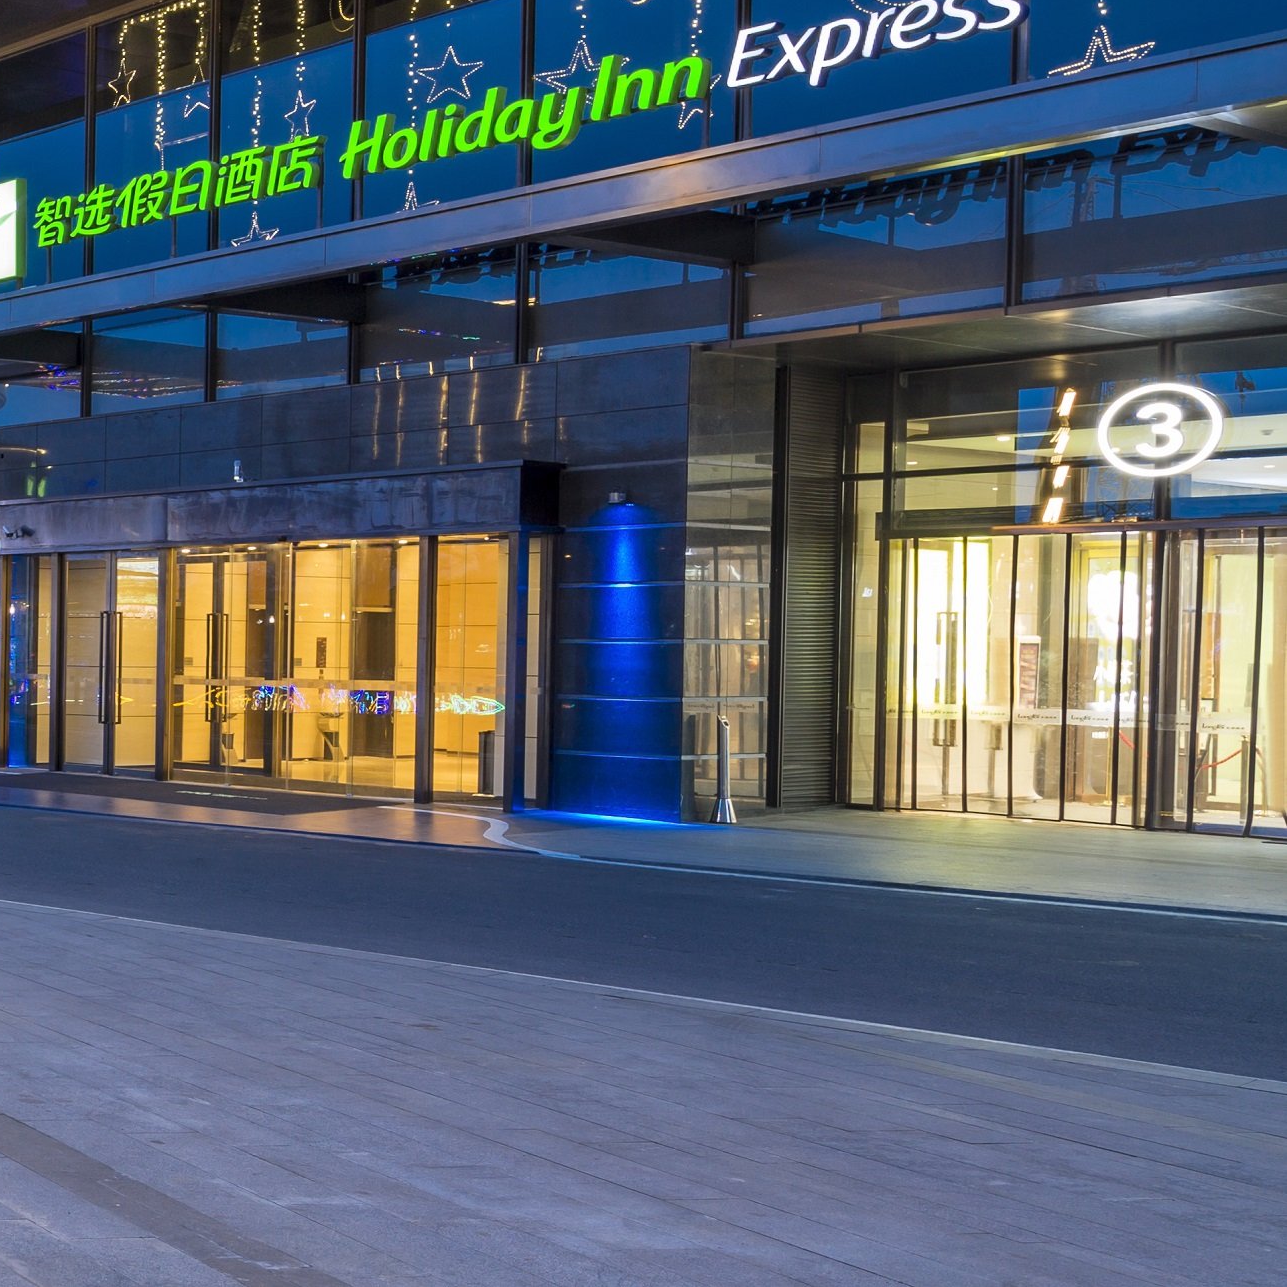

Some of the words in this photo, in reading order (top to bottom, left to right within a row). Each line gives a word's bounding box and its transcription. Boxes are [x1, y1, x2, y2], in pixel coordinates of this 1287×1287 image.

[339, 86, 585, 180] Holiday
[590, 54, 709, 122] Inn
[34, 138, 320, 249] 智选假日酒店
[1135, 402, 1184, 459] 3
